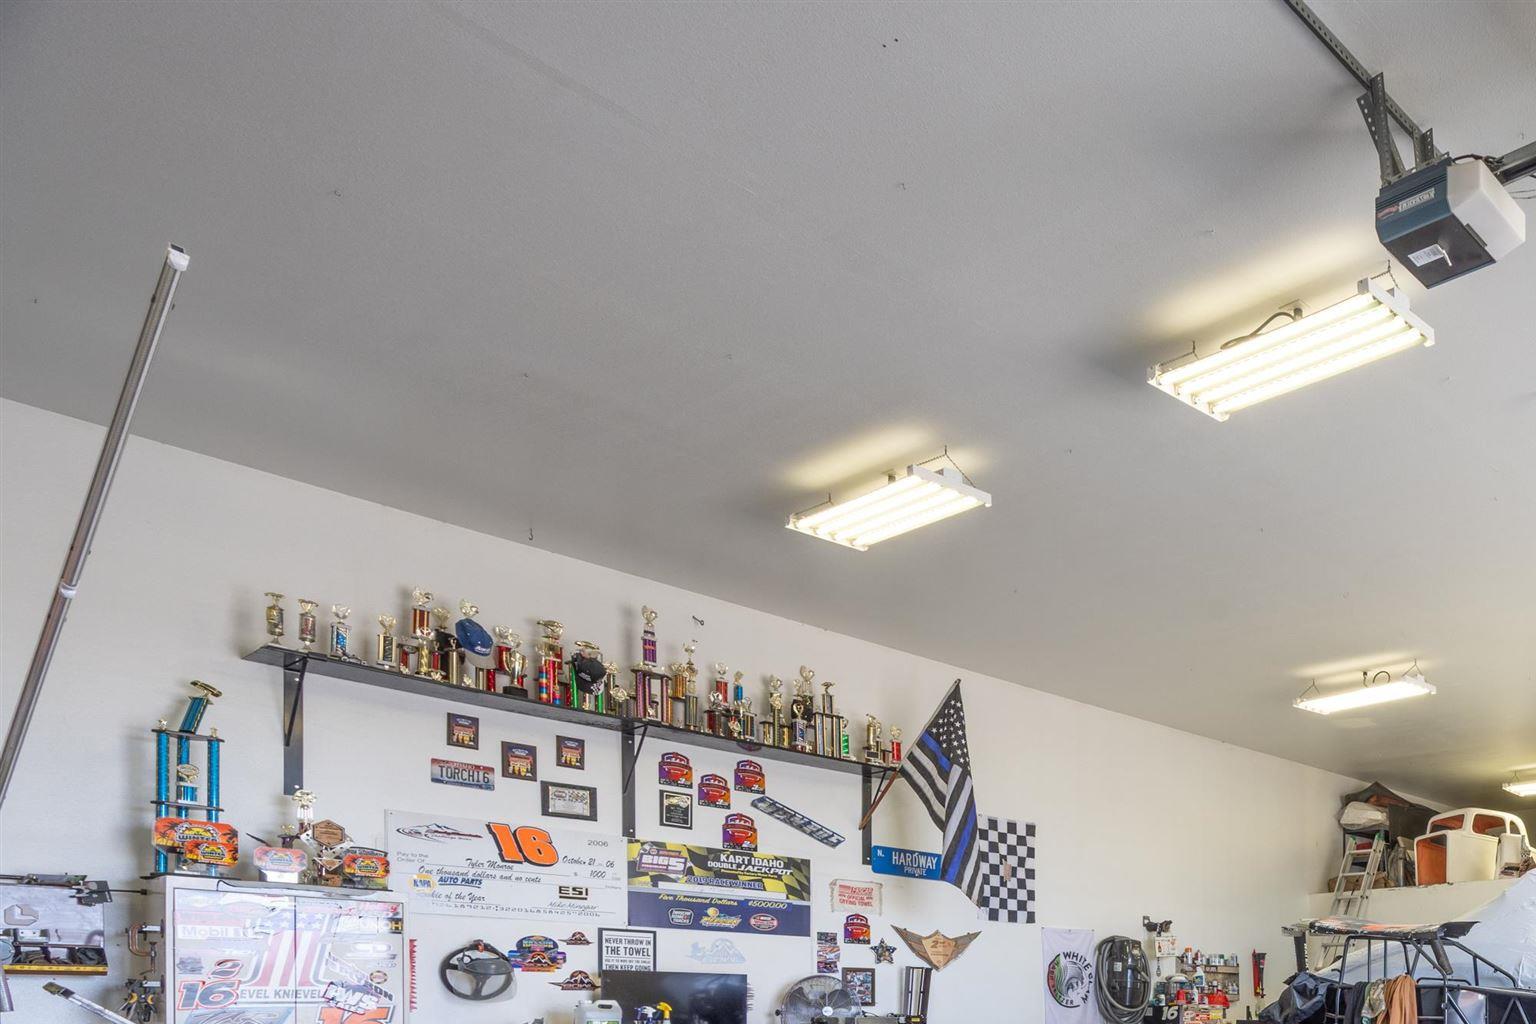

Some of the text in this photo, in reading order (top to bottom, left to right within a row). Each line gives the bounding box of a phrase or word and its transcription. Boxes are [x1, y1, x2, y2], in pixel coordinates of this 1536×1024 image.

[486, 822, 559, 868] 16
[587, 839, 609, 848] 2006
[465, 858, 514, 871] Tyler Monroe
[562, 856, 586, 866] October
[720, 854, 784, 868] KART IDAHO
[892, 851, 938, 870] HARDWAY
[418, 865, 434, 874] One
[436, 867, 469, 878] thousand
[472, 869, 497, 880] dollars
[499, 873, 513, 881] and
[590, 870, 606, 879] 1000
[708, 860, 793, 876] DOUBLE JACKPOT
[904, 866, 927, 876] PRIVATE
[438, 876, 459, 884] AUTO
[460, 877, 483, 886] PARTS
[687, 874, 708, 884] 2019
[731, 879, 763, 889] WINNER
[454, 890, 466, 900] the
[467, 892, 486, 903] Year
[559, 886, 588, 897] ESI
[658, 893, 674, 901] Five
[675, 895, 711, 904] Thousand
[711, 898, 738, 907] Dollars
[604, 937, 623, 945] NEVER
[623, 938, 645, 946] THROW
[605, 945, 651, 957] THE TOWEL
[1062, 951, 1093, 971] WHITE
[177, 979, 242, 1011] 16
[240, 988, 323, 1000] EVEL KNIEVEL
[1161, 1006, 1179, 1020] 16
